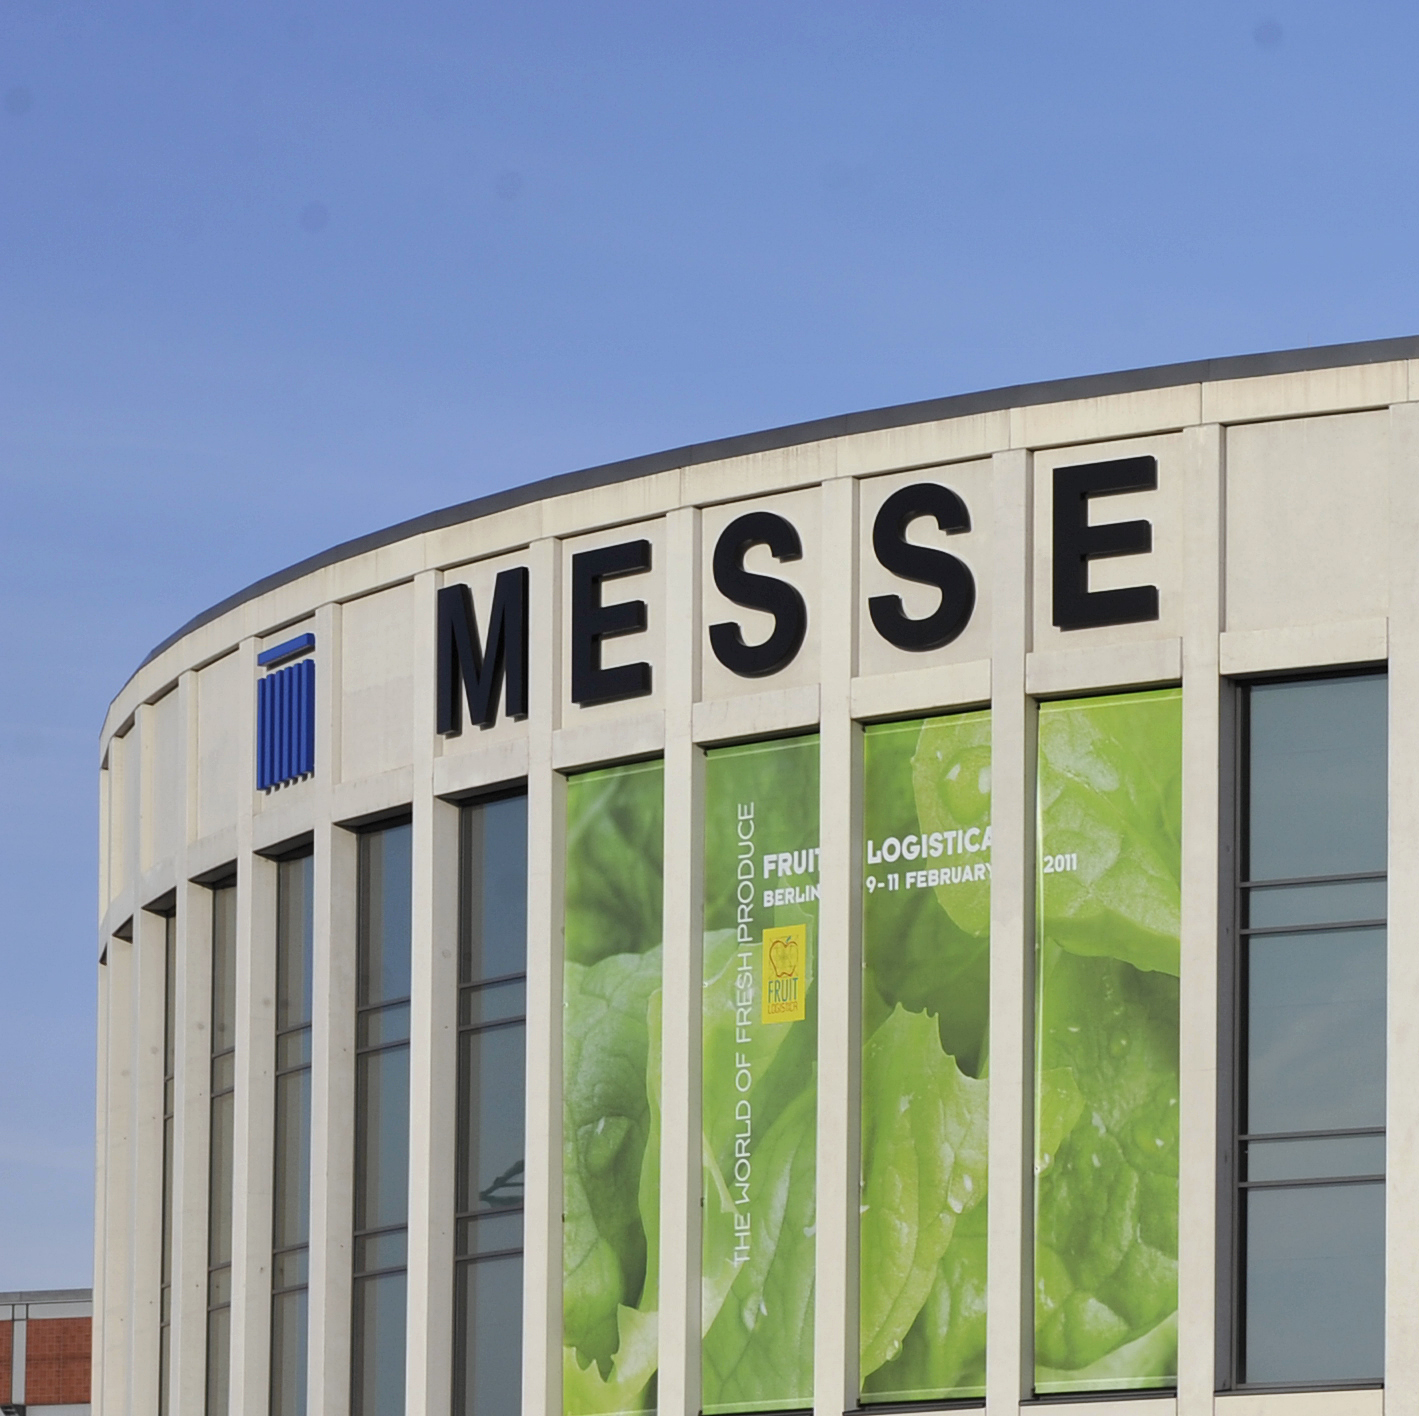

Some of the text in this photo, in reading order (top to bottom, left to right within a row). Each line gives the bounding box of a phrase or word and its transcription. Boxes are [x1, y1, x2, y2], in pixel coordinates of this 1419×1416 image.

[437, 454, 1160, 737] MESSE
[1043, 853, 1078, 874] 2011
[734, 802, 755, 1268] THE WORLD OF FRESH PRODUCE
[767, 978, 799, 1004] FRUIT
